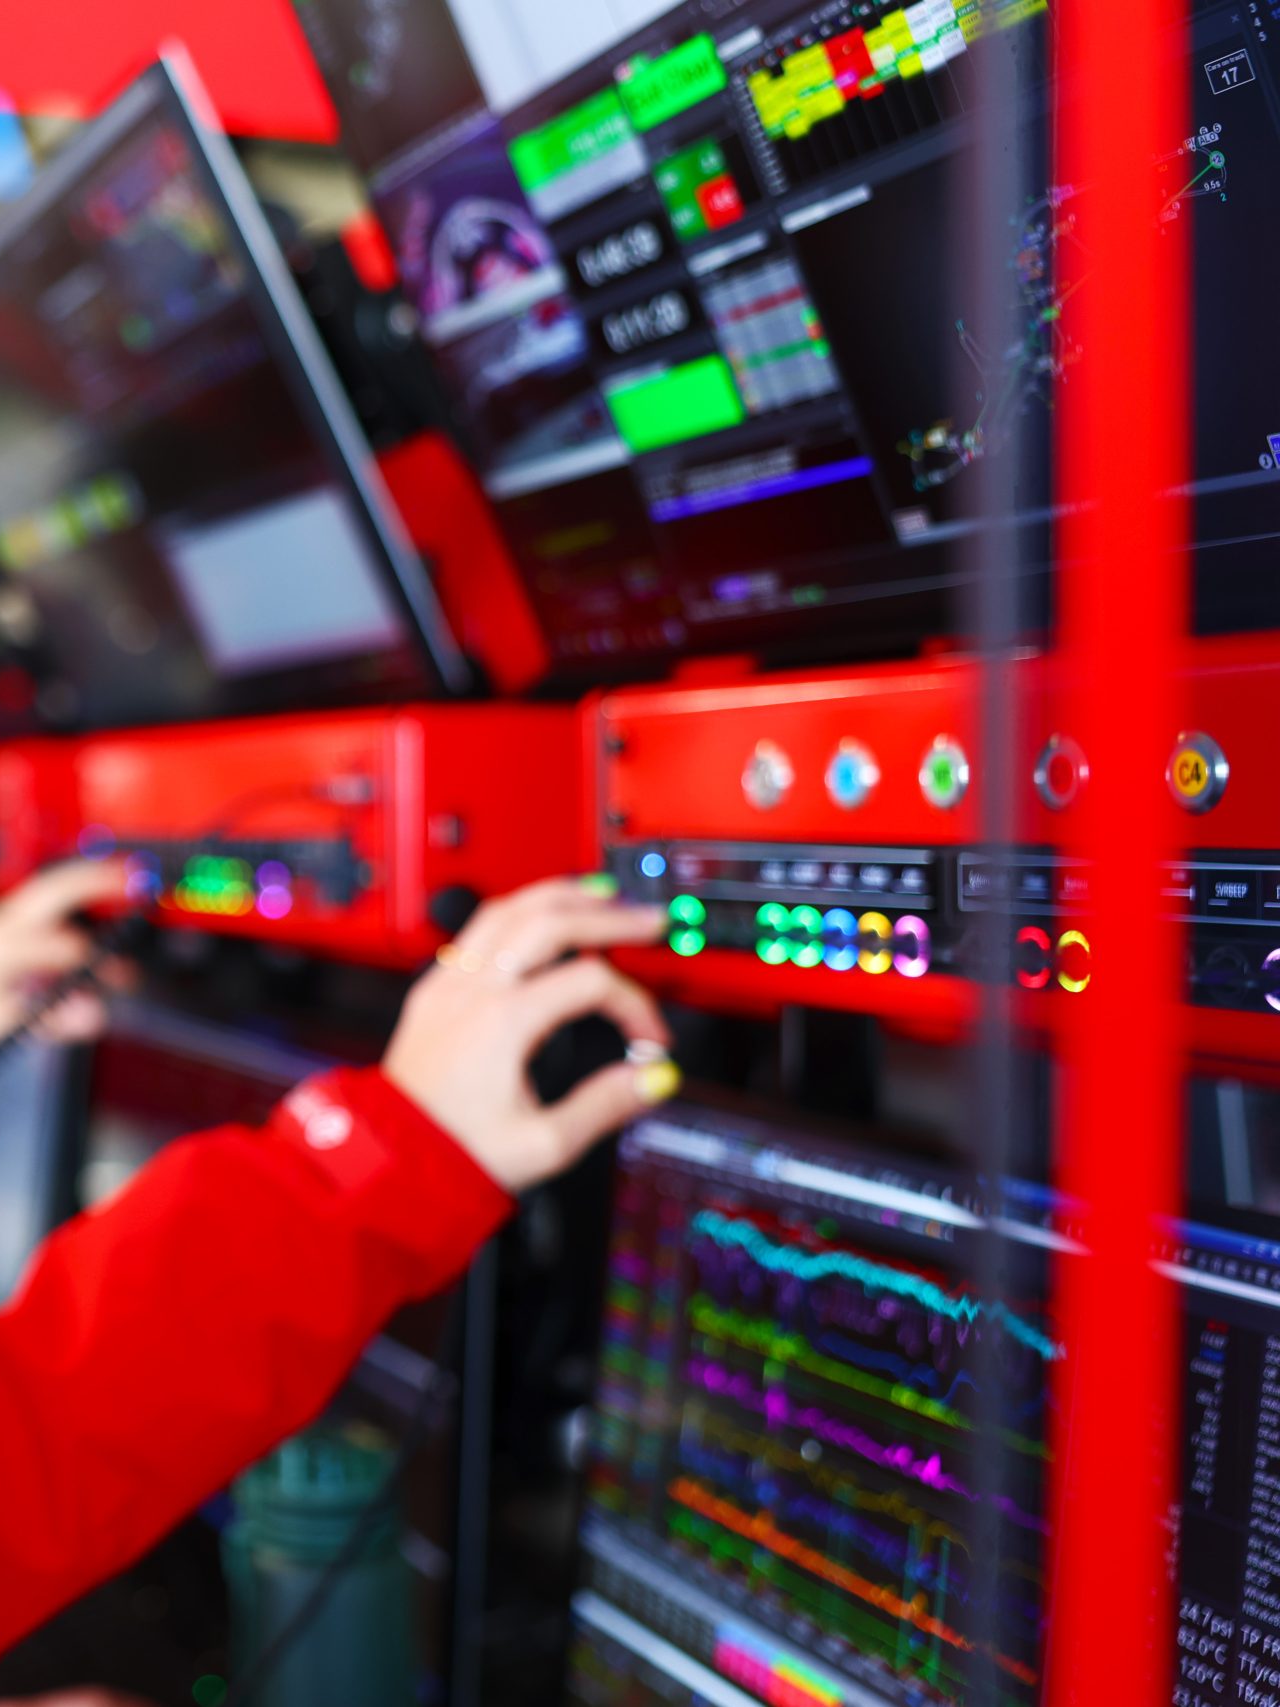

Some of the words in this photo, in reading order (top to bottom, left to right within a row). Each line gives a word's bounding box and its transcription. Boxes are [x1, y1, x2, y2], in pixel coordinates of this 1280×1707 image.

[1207, 63, 1221, 71] Cars
[1230, 53, 1245, 63] track
[1221, 66, 1237, 85] 17
[1199, 133, 1217, 145] ALO
[1204, 180, 1220, 191] 9.5s
[1220, 193, 1227, 202] 2
[1178, 760, 1202, 788] C4
[1238, 1650, 1280, 1690] TTyre
